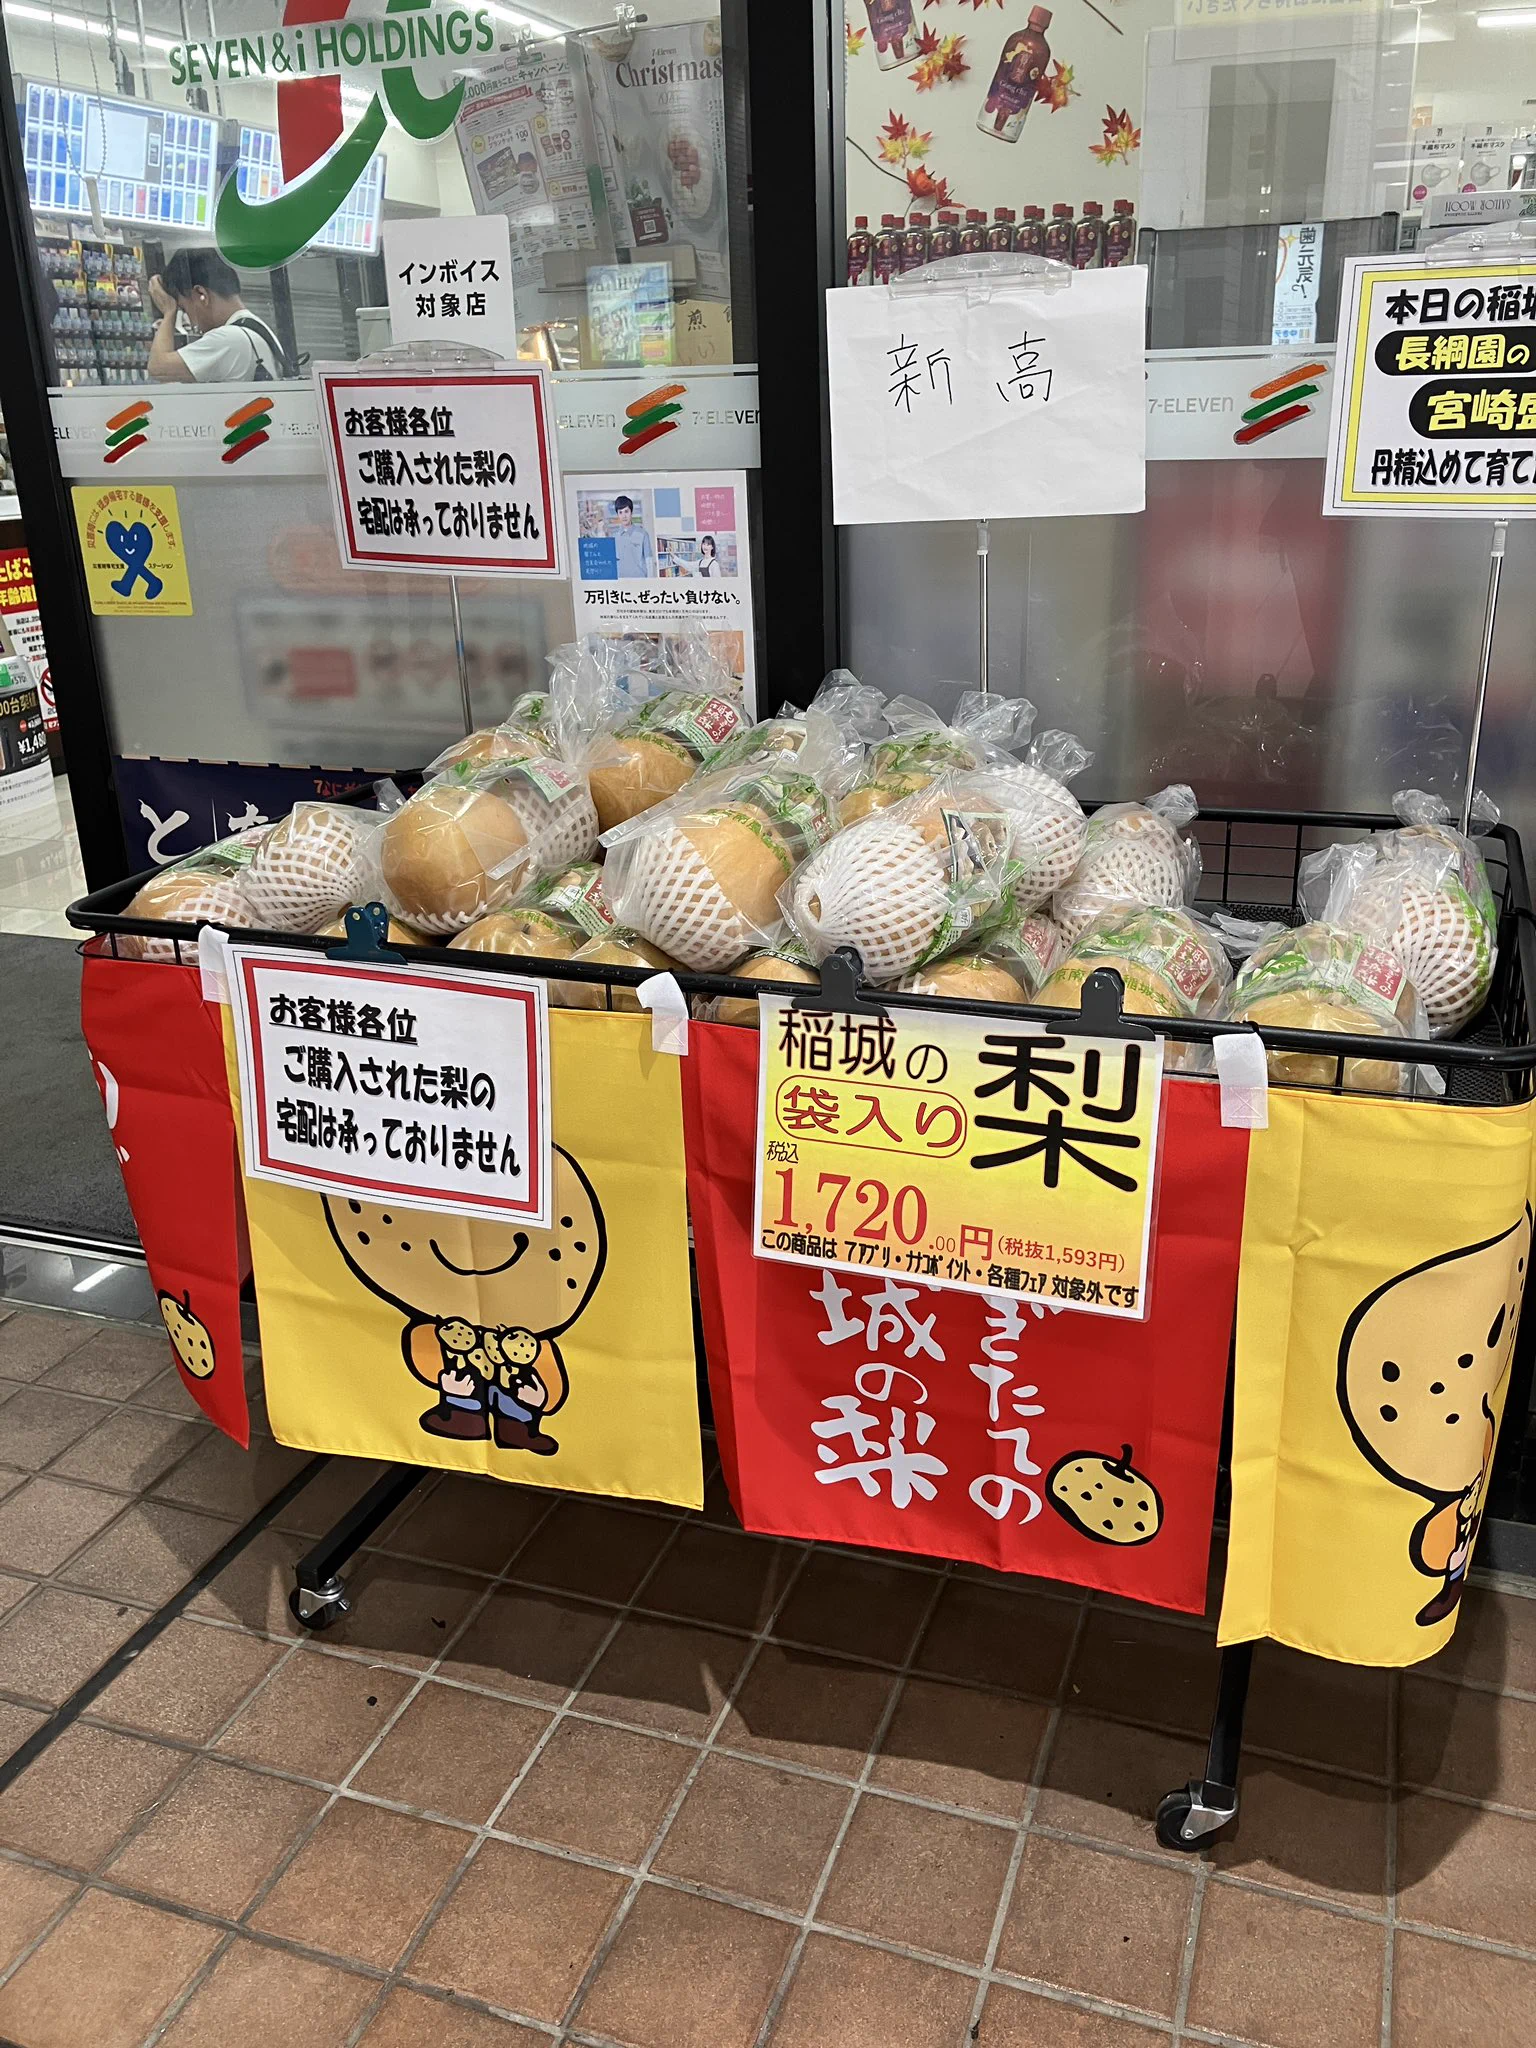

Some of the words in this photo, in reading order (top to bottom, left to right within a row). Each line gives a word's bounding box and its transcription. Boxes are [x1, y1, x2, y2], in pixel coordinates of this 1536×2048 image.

[316, 8, 494, 69] HOLDINGS
[615, 57, 723, 88] Christmas
[398, 260, 500, 286] インボイス
[415, 292, 487, 319] 対象店
[344, 406, 454, 436] お客様各位
[358, 449, 517, 488] ご購入された梨の
[357, 496, 540, 540] 宅配は承っておりません
[584, 590, 741, 606] 万引きに、ぜったい負けない。
[269, 993, 417, 1043] お客様各位
[778, 1007, 948, 1084] 稲城の
[284, 1045, 496, 1112] ご購入された梨の
[782, 1084, 963, 1149] 袋入り
[969, 1034, 1142, 1193] 梨
[277, 1097, 522, 1178] 宅配は承っておりません
[766, 1140, 799, 1165] 税込
[761, 1228, 837, 1260] この商品は
[1051, 1273, 1139, 1309] 対象外です
